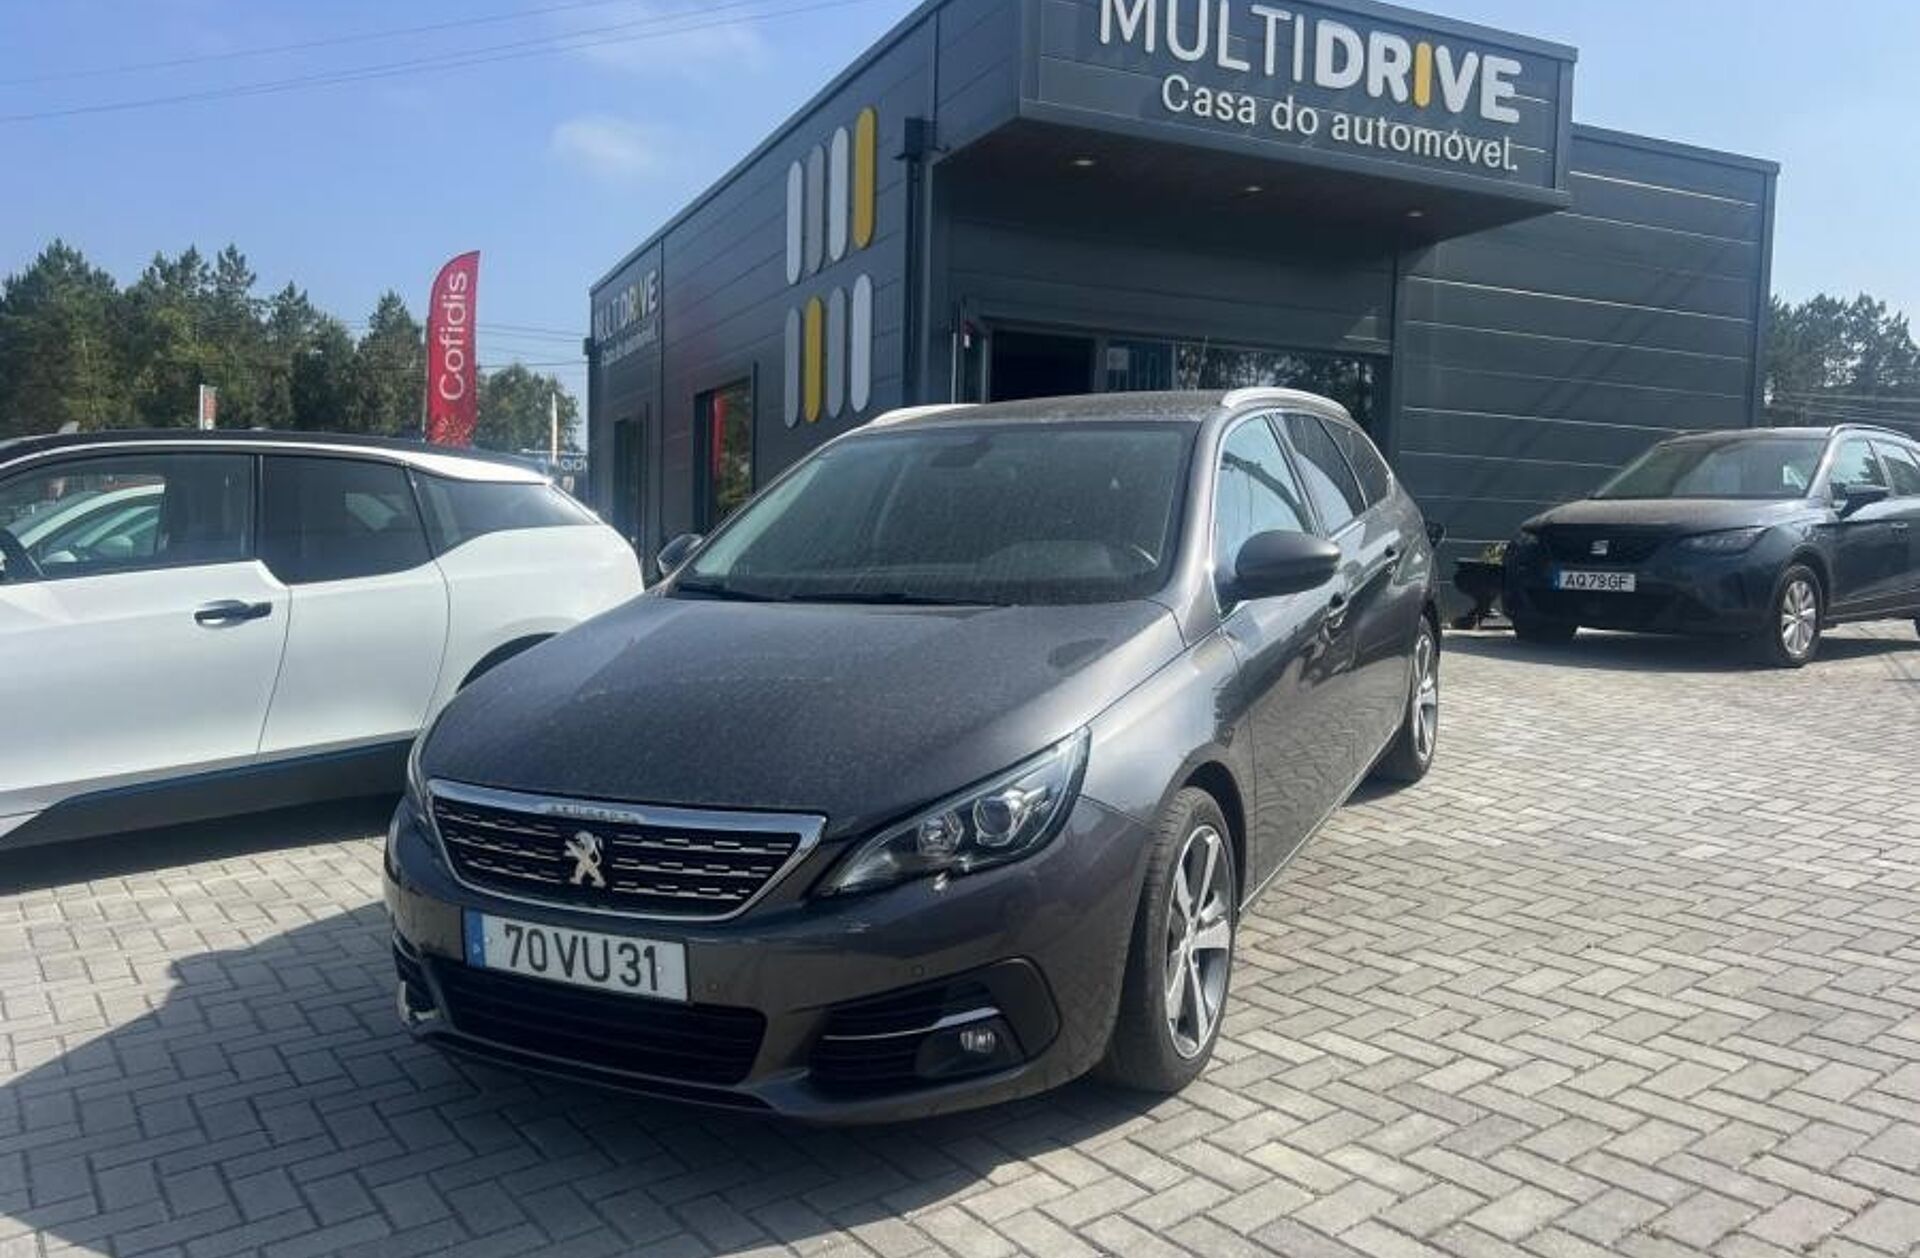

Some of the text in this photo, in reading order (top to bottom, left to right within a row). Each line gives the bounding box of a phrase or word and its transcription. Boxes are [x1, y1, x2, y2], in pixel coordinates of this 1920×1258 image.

[1100, 0, 1521, 123] MULTIDRIVE
[1162, 74, 1519, 171] Casa do automóvel.
[439, 271, 468, 401] Cofidis
[504, 923, 658, 991] 70VU31
